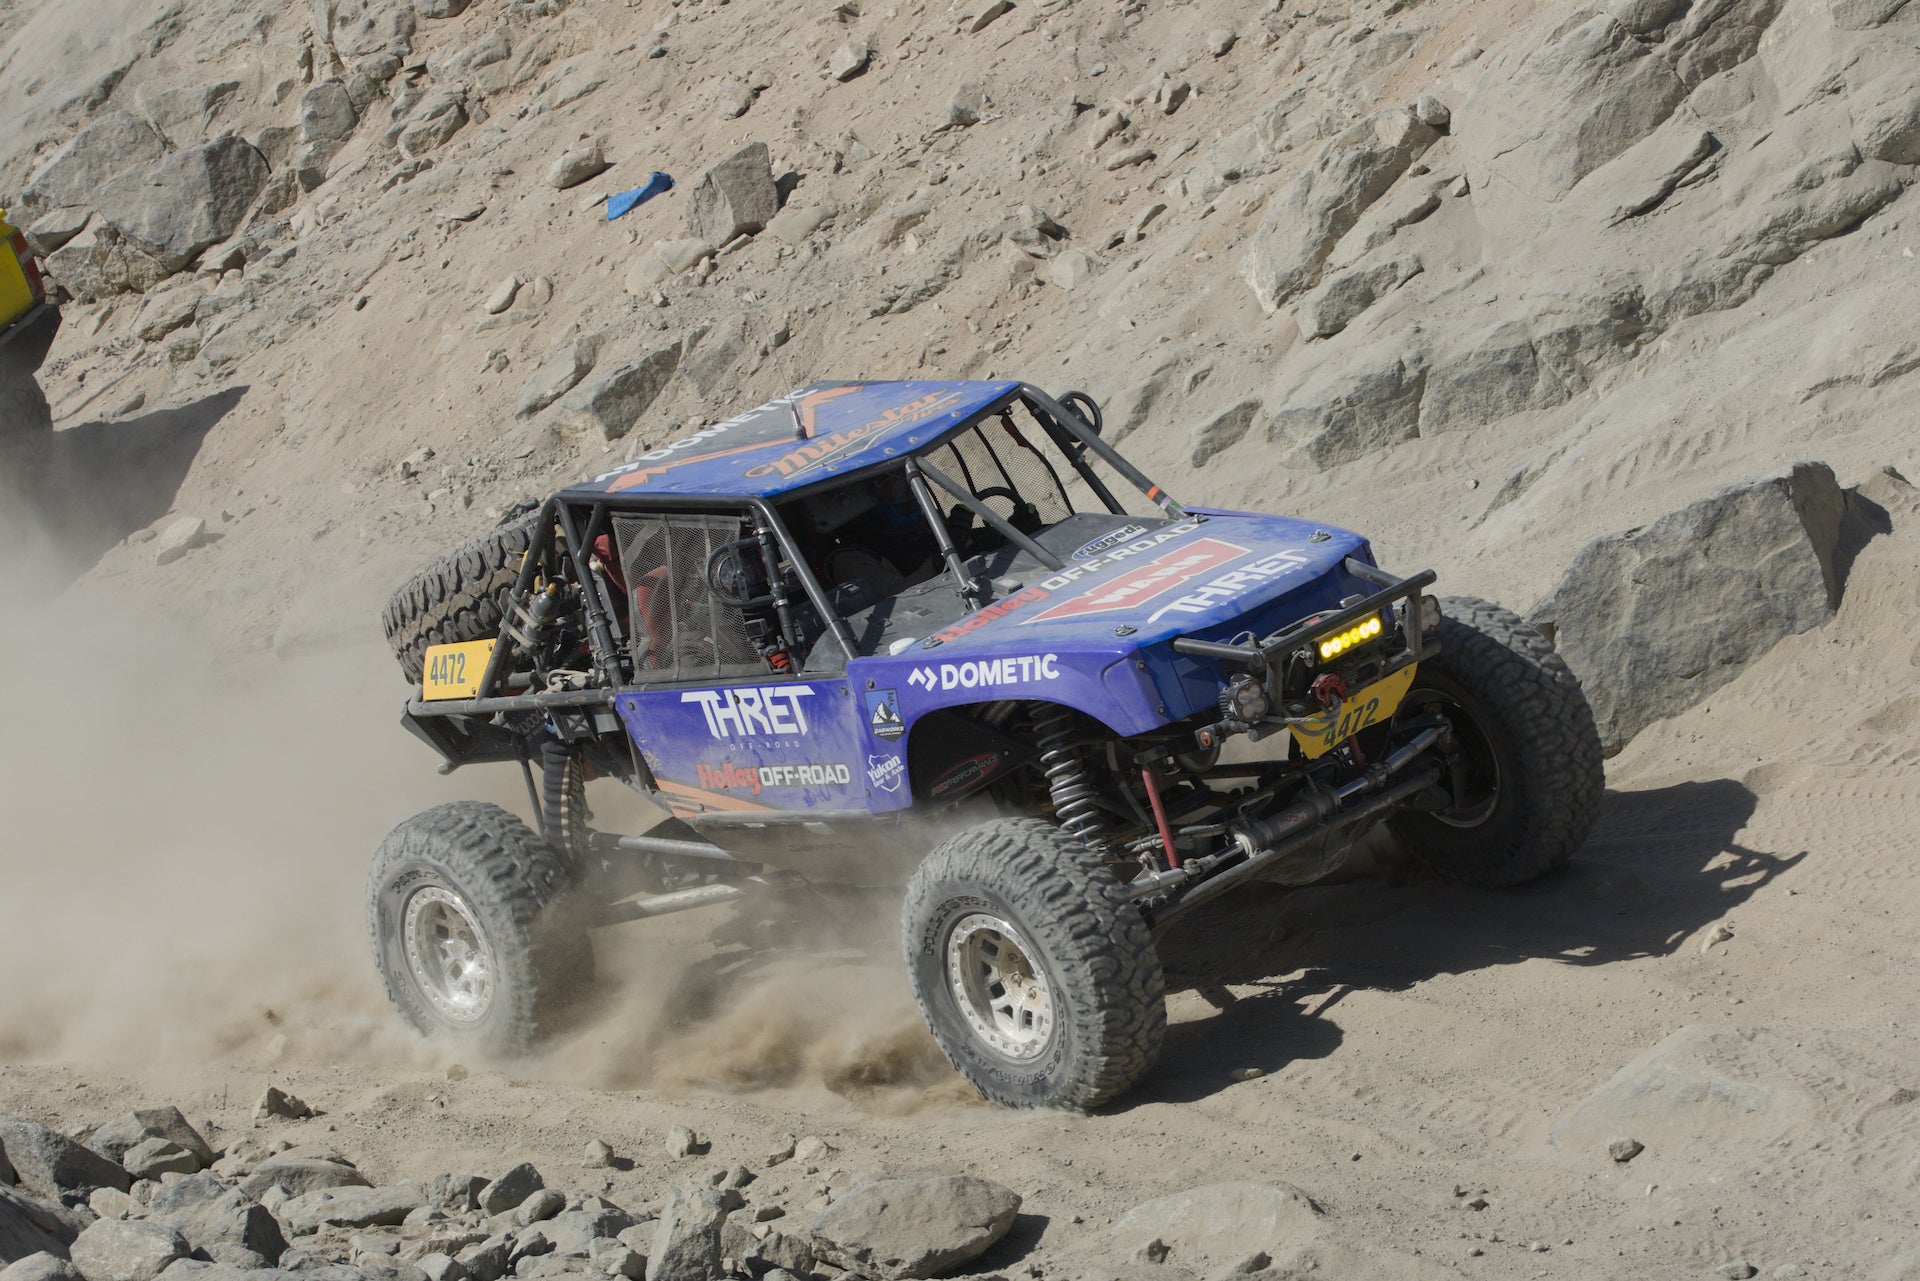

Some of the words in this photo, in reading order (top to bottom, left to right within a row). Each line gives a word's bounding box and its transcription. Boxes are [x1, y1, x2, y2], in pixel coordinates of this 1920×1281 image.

[646, 388, 818, 462] DOMETIC
[744, 388, 948, 478] Milestar
[1040, 523, 1200, 591] OFF-ROAD
[1088, 554, 1215, 607] WARN
[1147, 548, 1309, 625] THRET
[430, 652, 466, 686] 4472
[941, 653, 1060, 691] DOMETIC
[680, 684, 816, 741] THRET
[1323, 697, 1380, 748] 4472
[729, 740, 800, 751] OFF-ROAD
[867, 755, 902, 780] Yukon
[696, 761, 762, 796] Holley
[758, 763, 851, 787] OFF-ROAD
